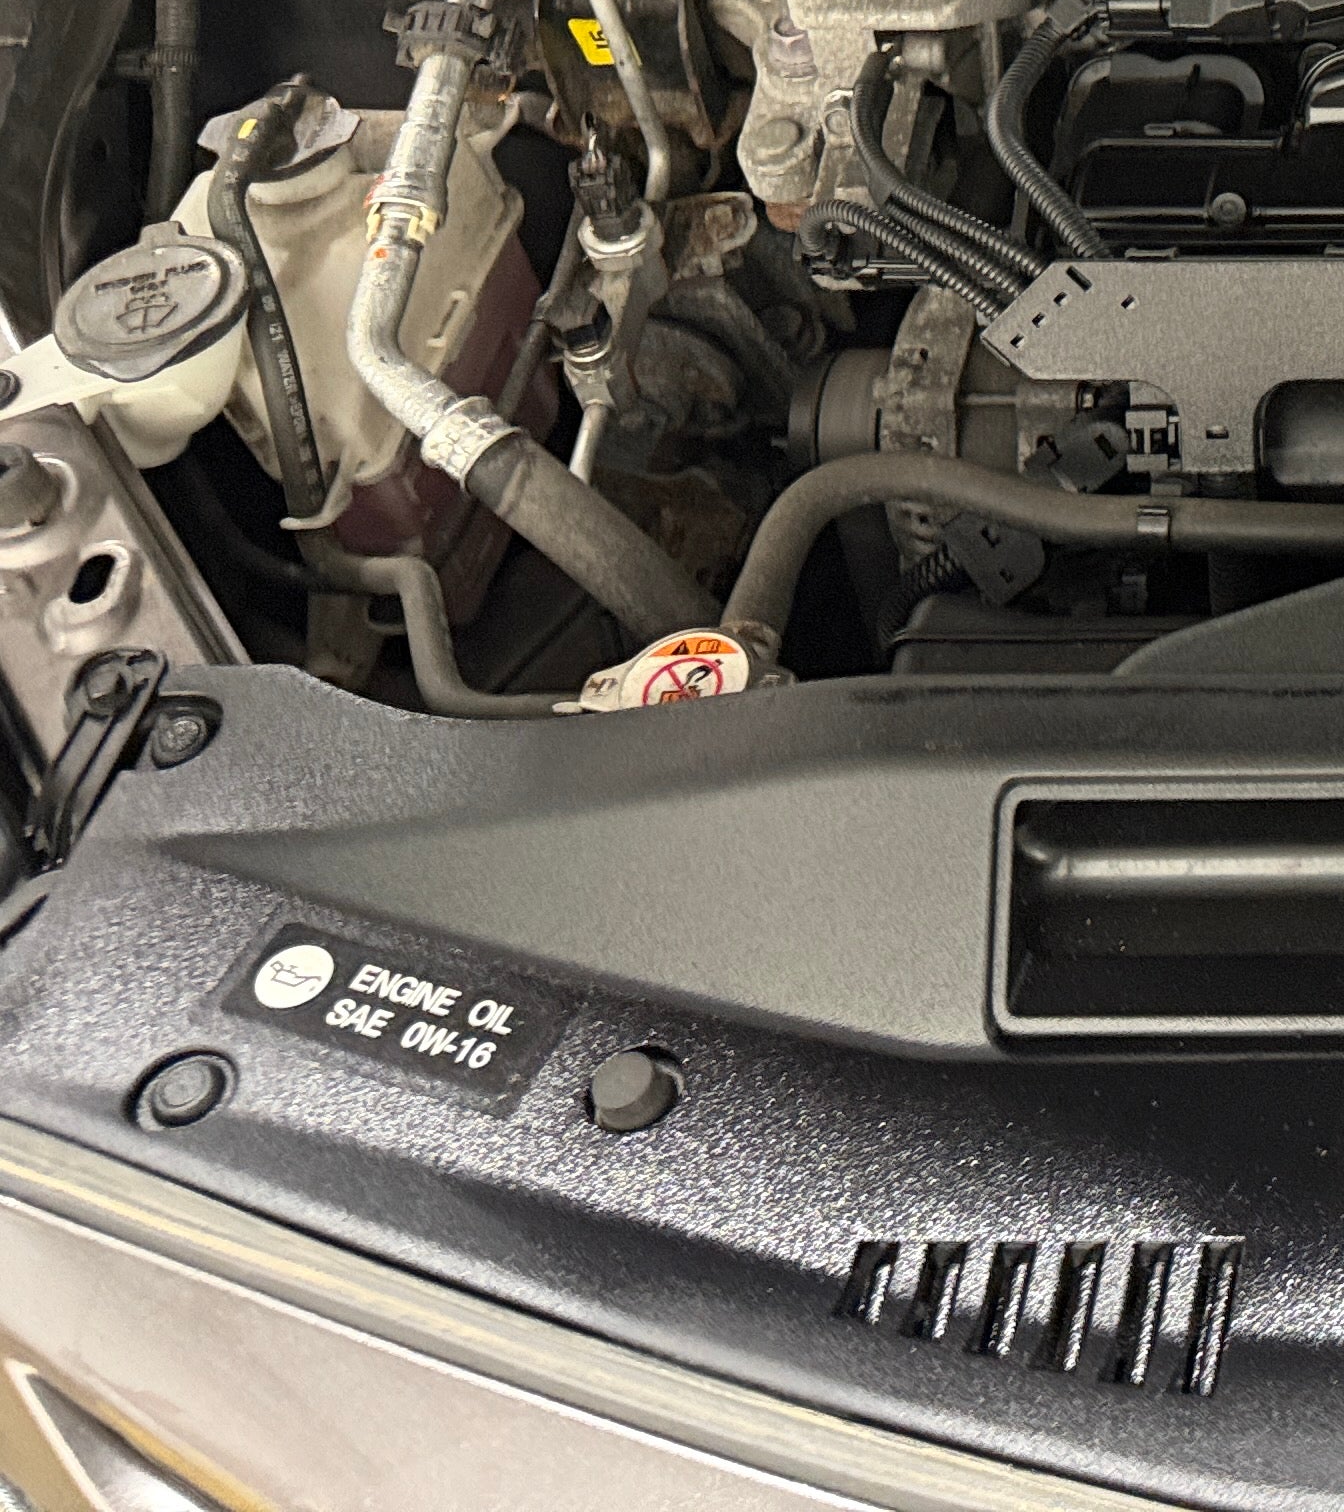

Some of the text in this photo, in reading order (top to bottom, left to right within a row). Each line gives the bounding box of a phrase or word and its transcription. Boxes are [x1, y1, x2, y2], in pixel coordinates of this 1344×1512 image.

[326, 999, 497, 1069] SAE 0W-16
[349, 965, 514, 1035] ENGINE OIL
